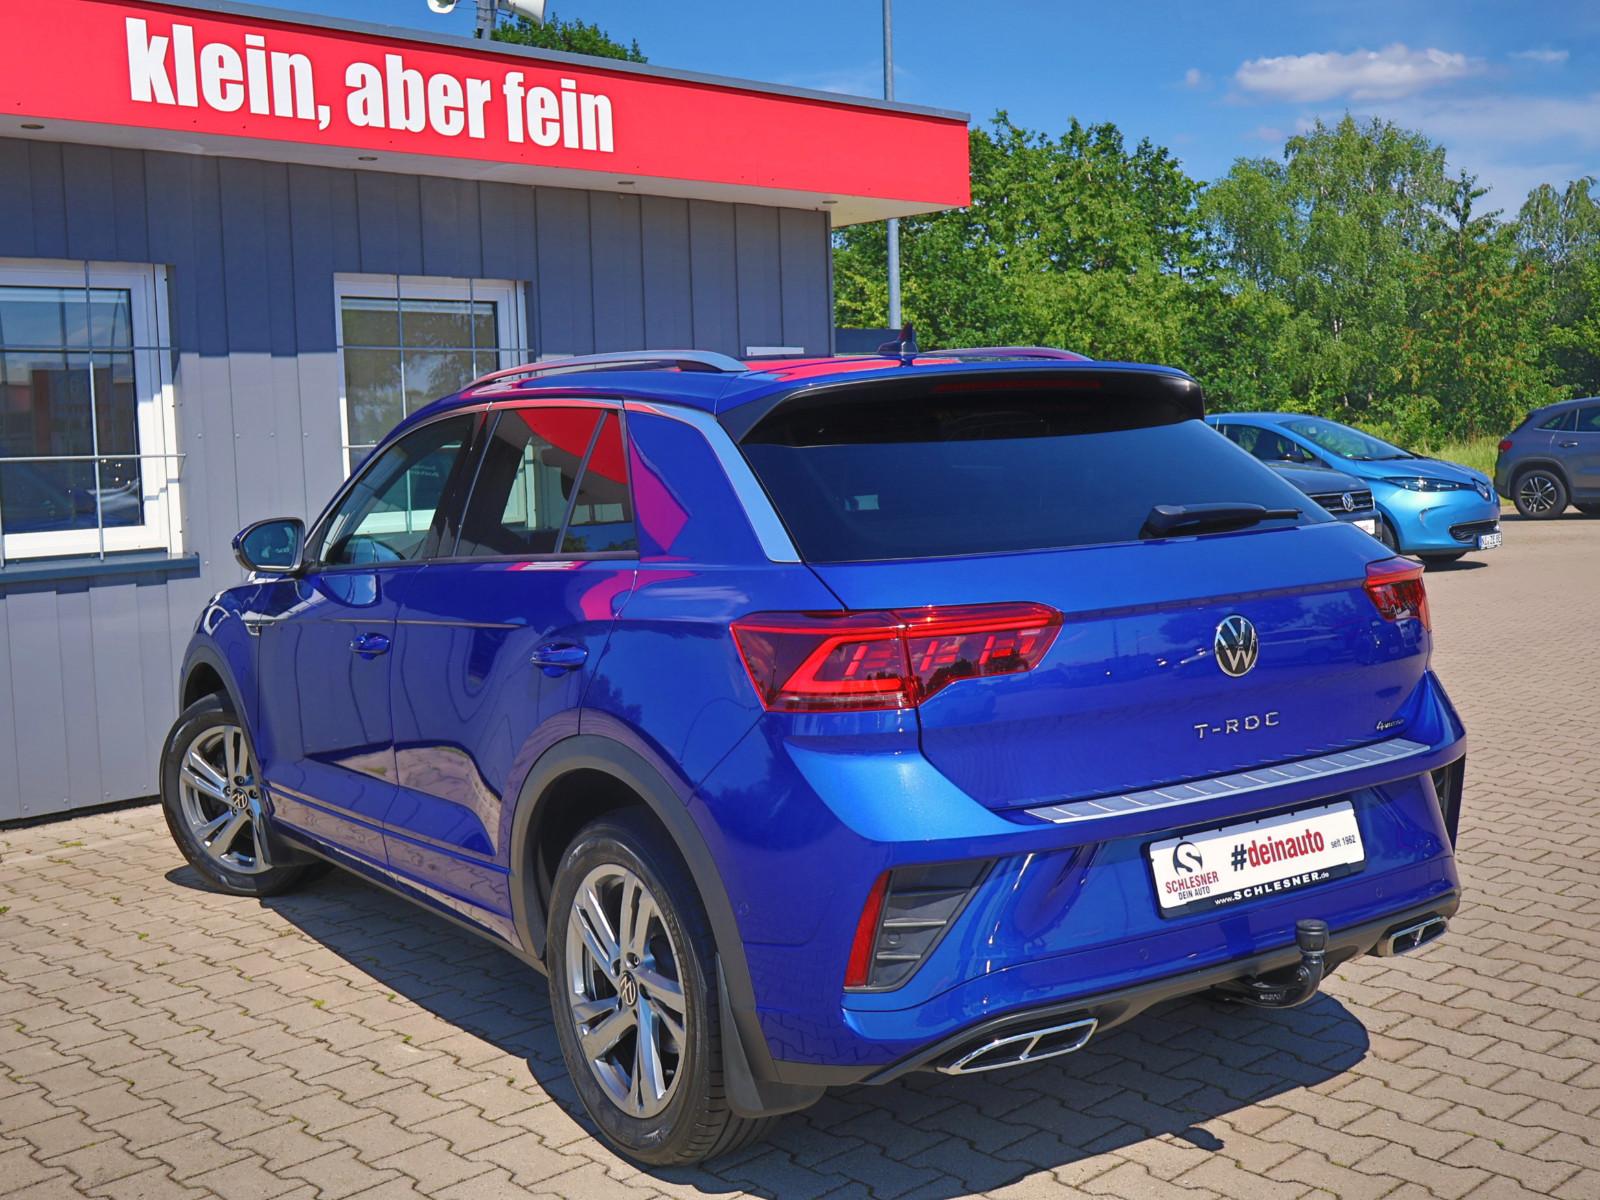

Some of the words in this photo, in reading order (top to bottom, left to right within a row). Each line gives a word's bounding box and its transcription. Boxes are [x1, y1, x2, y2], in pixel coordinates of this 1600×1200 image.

[125, 17, 331, 130] klein,
[344, 54, 492, 140] aber
[502, 71, 615, 153] fein
[1194, 712, 1280, 739] T-ROC
[1231, 829, 1325, 872] #deinauto
[1165, 871, 1219, 894] SCHLESNER
[1178, 891, 1193, 901] DEIN
[1194, 886, 1211, 898] AUTO
[1214, 871, 1330, 905] www.SCHLESNER.de
